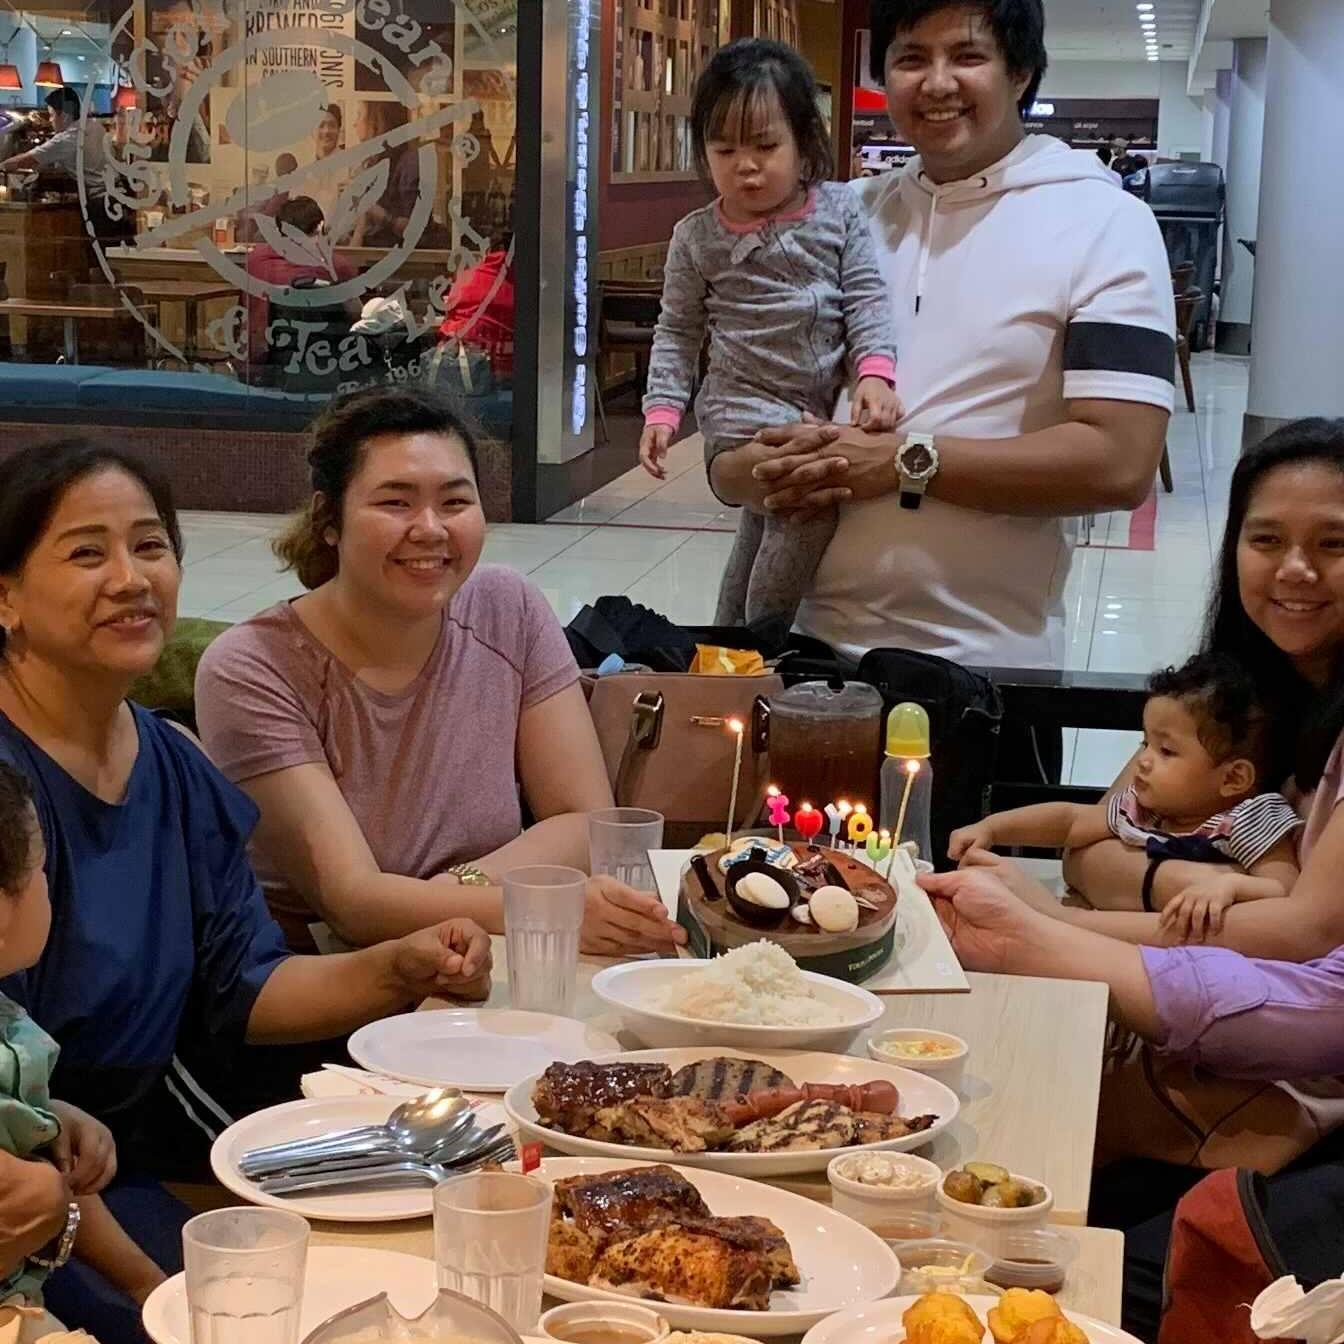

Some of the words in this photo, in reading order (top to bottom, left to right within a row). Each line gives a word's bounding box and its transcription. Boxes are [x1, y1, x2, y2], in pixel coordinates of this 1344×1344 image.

[262, 47, 317, 67] SOUTHERN
[320, 50, 344, 88] SINC
[265, 319, 373, 375] Tea
